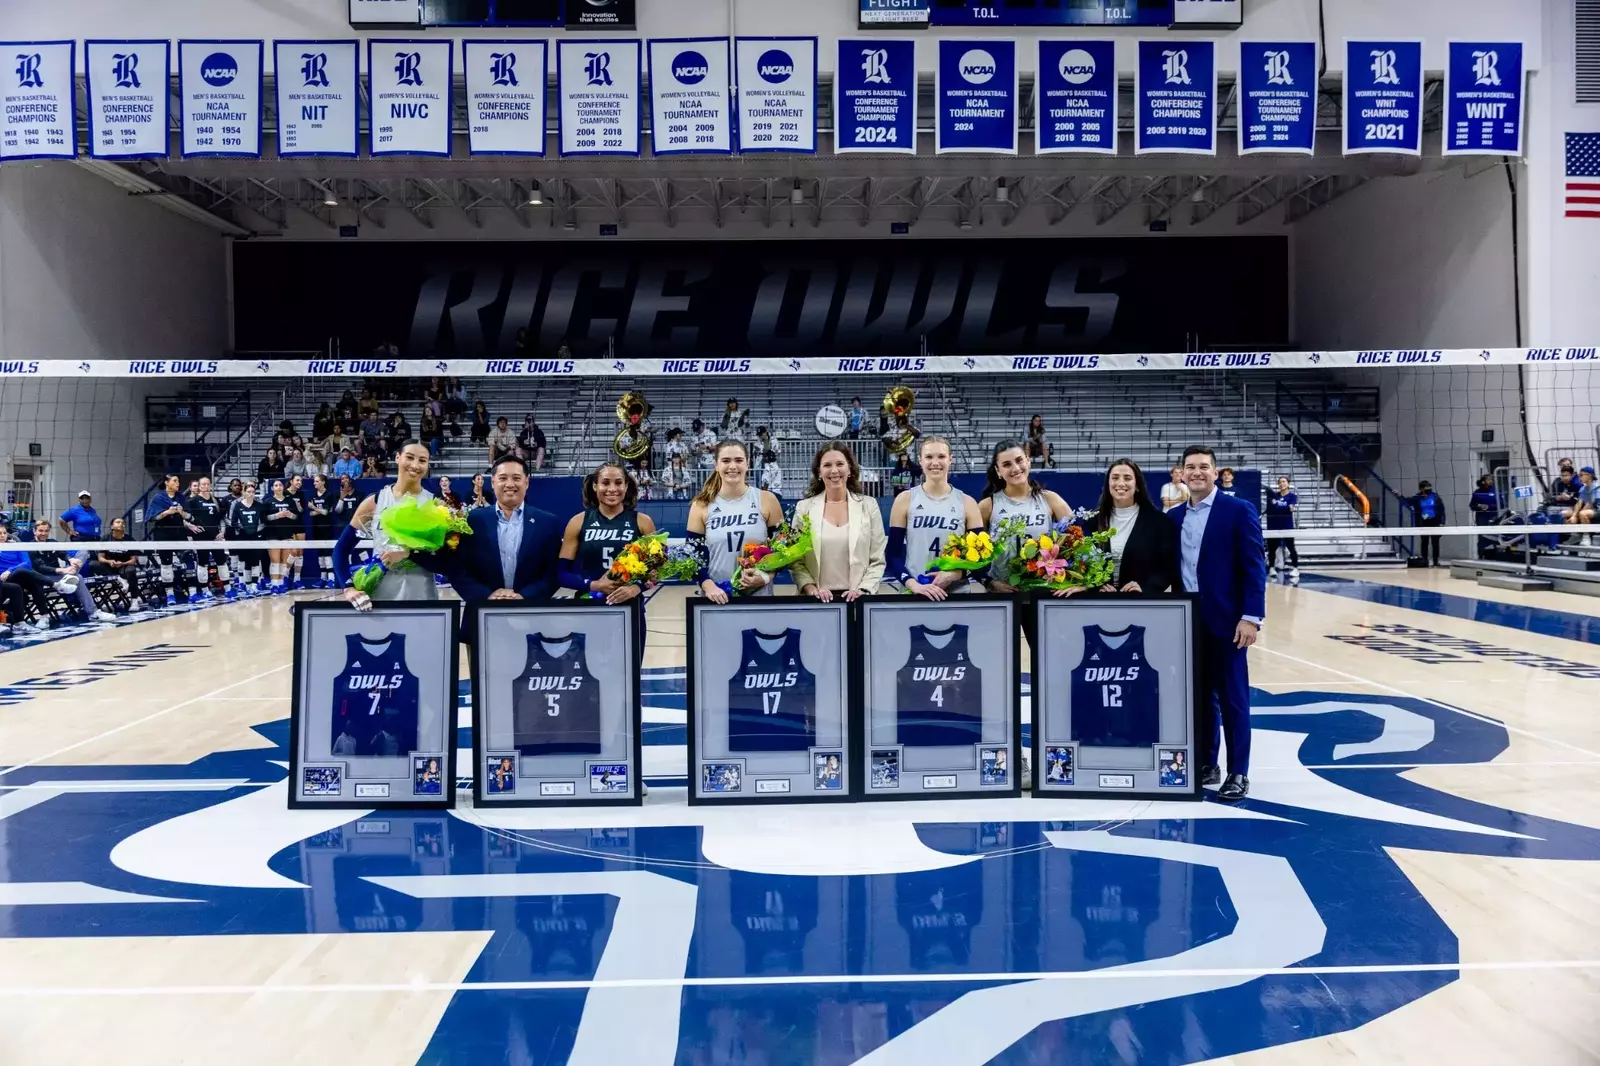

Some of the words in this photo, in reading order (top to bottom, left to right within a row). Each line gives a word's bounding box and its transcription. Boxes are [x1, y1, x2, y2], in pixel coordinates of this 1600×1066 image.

[973, 8, 999, 18] T.O.L.
[1105, 8, 1131, 18] T.O.L.
[204, 68, 237, 78] NCAA
[676, 67, 708, 77] NCAA
[761, 66, 793, 75] NCAA
[963, 66, 994, 74] NCAA
[1063, 66, 1094, 74] NCAA
[6, 104, 57, 113] CONFERENCE
[478, 102, 530, 110] CONFERENCE
[680, 101, 702, 109] NCAA
[765, 99, 786, 107] NCAA
[966, 99, 988, 107] NCAA
[1067, 99, 1089, 107] NCAA
[1151, 100, 1203, 108] CONFERENCE
[103, 105, 153, 113] CONFERENCE
[302, 106, 328, 120] NIT
[391, 104, 428, 118] NIVC
[664, 110, 719, 119] TOURNAMENT
[748, 109, 803, 117] TOURNAMENT
[950, 110, 1005, 118] TOURNAMENT
[1050, 110, 1105, 118] TOURNAMENT
[1153, 109, 1200, 118] CHAMPIONS
[1362, 109, 1409, 118] CHAMPIONS
[1466, 103, 1506, 119] WNIT
[8, 114, 56, 123] CHAMPIONS
[105, 115, 151, 123] CHAMPIONS
[192, 113, 246, 121] TOURNAMENT
[480, 112, 529, 120] CHAMPIONS
[696, 124, 714, 132] 2009
[954, 123, 973, 131] 2024
[1146, 127, 1166, 135] 2005
[1168, 127, 1186, 135] 2019
[1189, 127, 1206, 136] 2020
[1365, 124, 1404, 140] 2021
[855, 127, 897, 143] 2024
[406, 256, 712, 355] RICE
[744, 256, 1128, 356] OWLS
[1185, 354, 1221, 366] RICE
[1225, 353, 1271, 366] OWLS
[1356, 352, 1392, 363] RICE
[1396, 351, 1442, 363] OWLS
[1526, 349, 1562, 360] RICE
[129, 362, 165, 373] RICE
[171, 362, 218, 373] OWLS
[308, 361, 345, 373] RICE
[350, 361, 397, 373] OWLS
[486, 361, 523, 372] RICE
[528, 361, 575, 372] OWLS
[662, 360, 698, 372] RICE
[704, 360, 750, 372] OWLS
[838, 359, 875, 371] RICE
[879, 358, 925, 370] OWLS
[1012, 357, 1049, 369] RICE
[1053, 356, 1099, 368] OWLS
[711, 513, 759, 529] OWLS
[913, 516, 959, 530] OWLS
[584, 529, 634, 541] OWLS
[727, 531, 745, 552] 17
[929, 537, 940, 557] 4
[602, 547, 615, 569] 5
[913, 667, 966, 681] OWLS
[1085, 667, 1139, 681] OWLS
[349, 675, 404, 689] OWLS
[528, 676, 582, 690] OWLS
[745, 672, 798, 689] OWLS
[931, 685, 943, 707] 4
[1102, 684, 1122, 707] 12
[368, 693, 380, 715] 7
[547, 694, 560, 717] 5
[763, 692, 781, 714] 17
